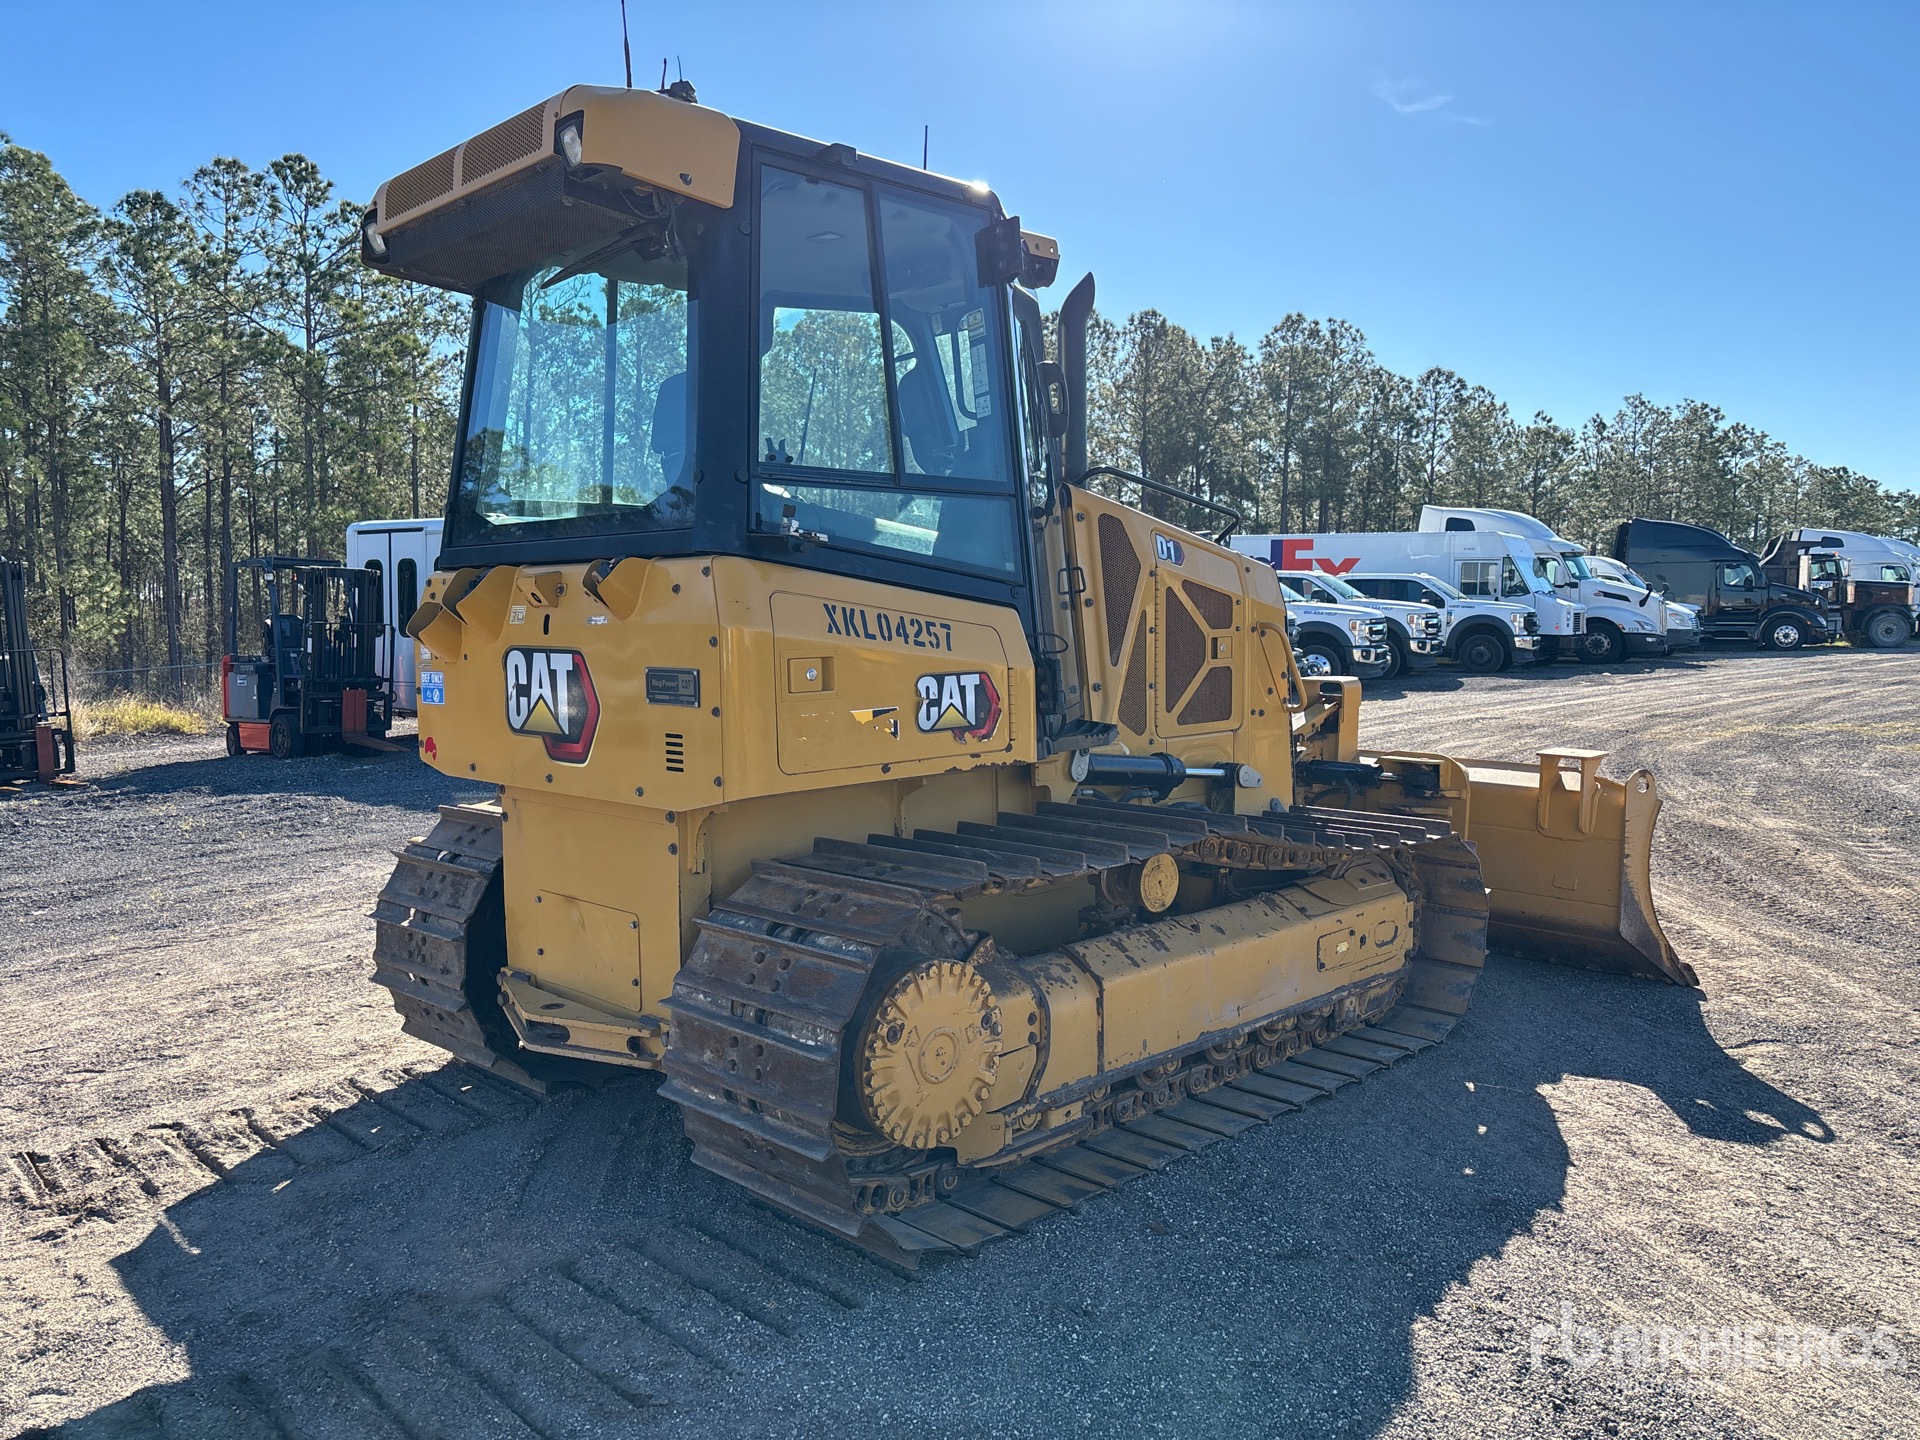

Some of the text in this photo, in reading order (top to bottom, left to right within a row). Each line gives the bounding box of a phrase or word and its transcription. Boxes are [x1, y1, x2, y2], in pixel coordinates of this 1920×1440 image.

[1156, 534, 1176, 562] D1
[823, 603, 952, 651] XKL04257
[421, 673, 431, 683] DEF
[506, 650, 573, 735] CAT
[917, 673, 980, 731] CAT
